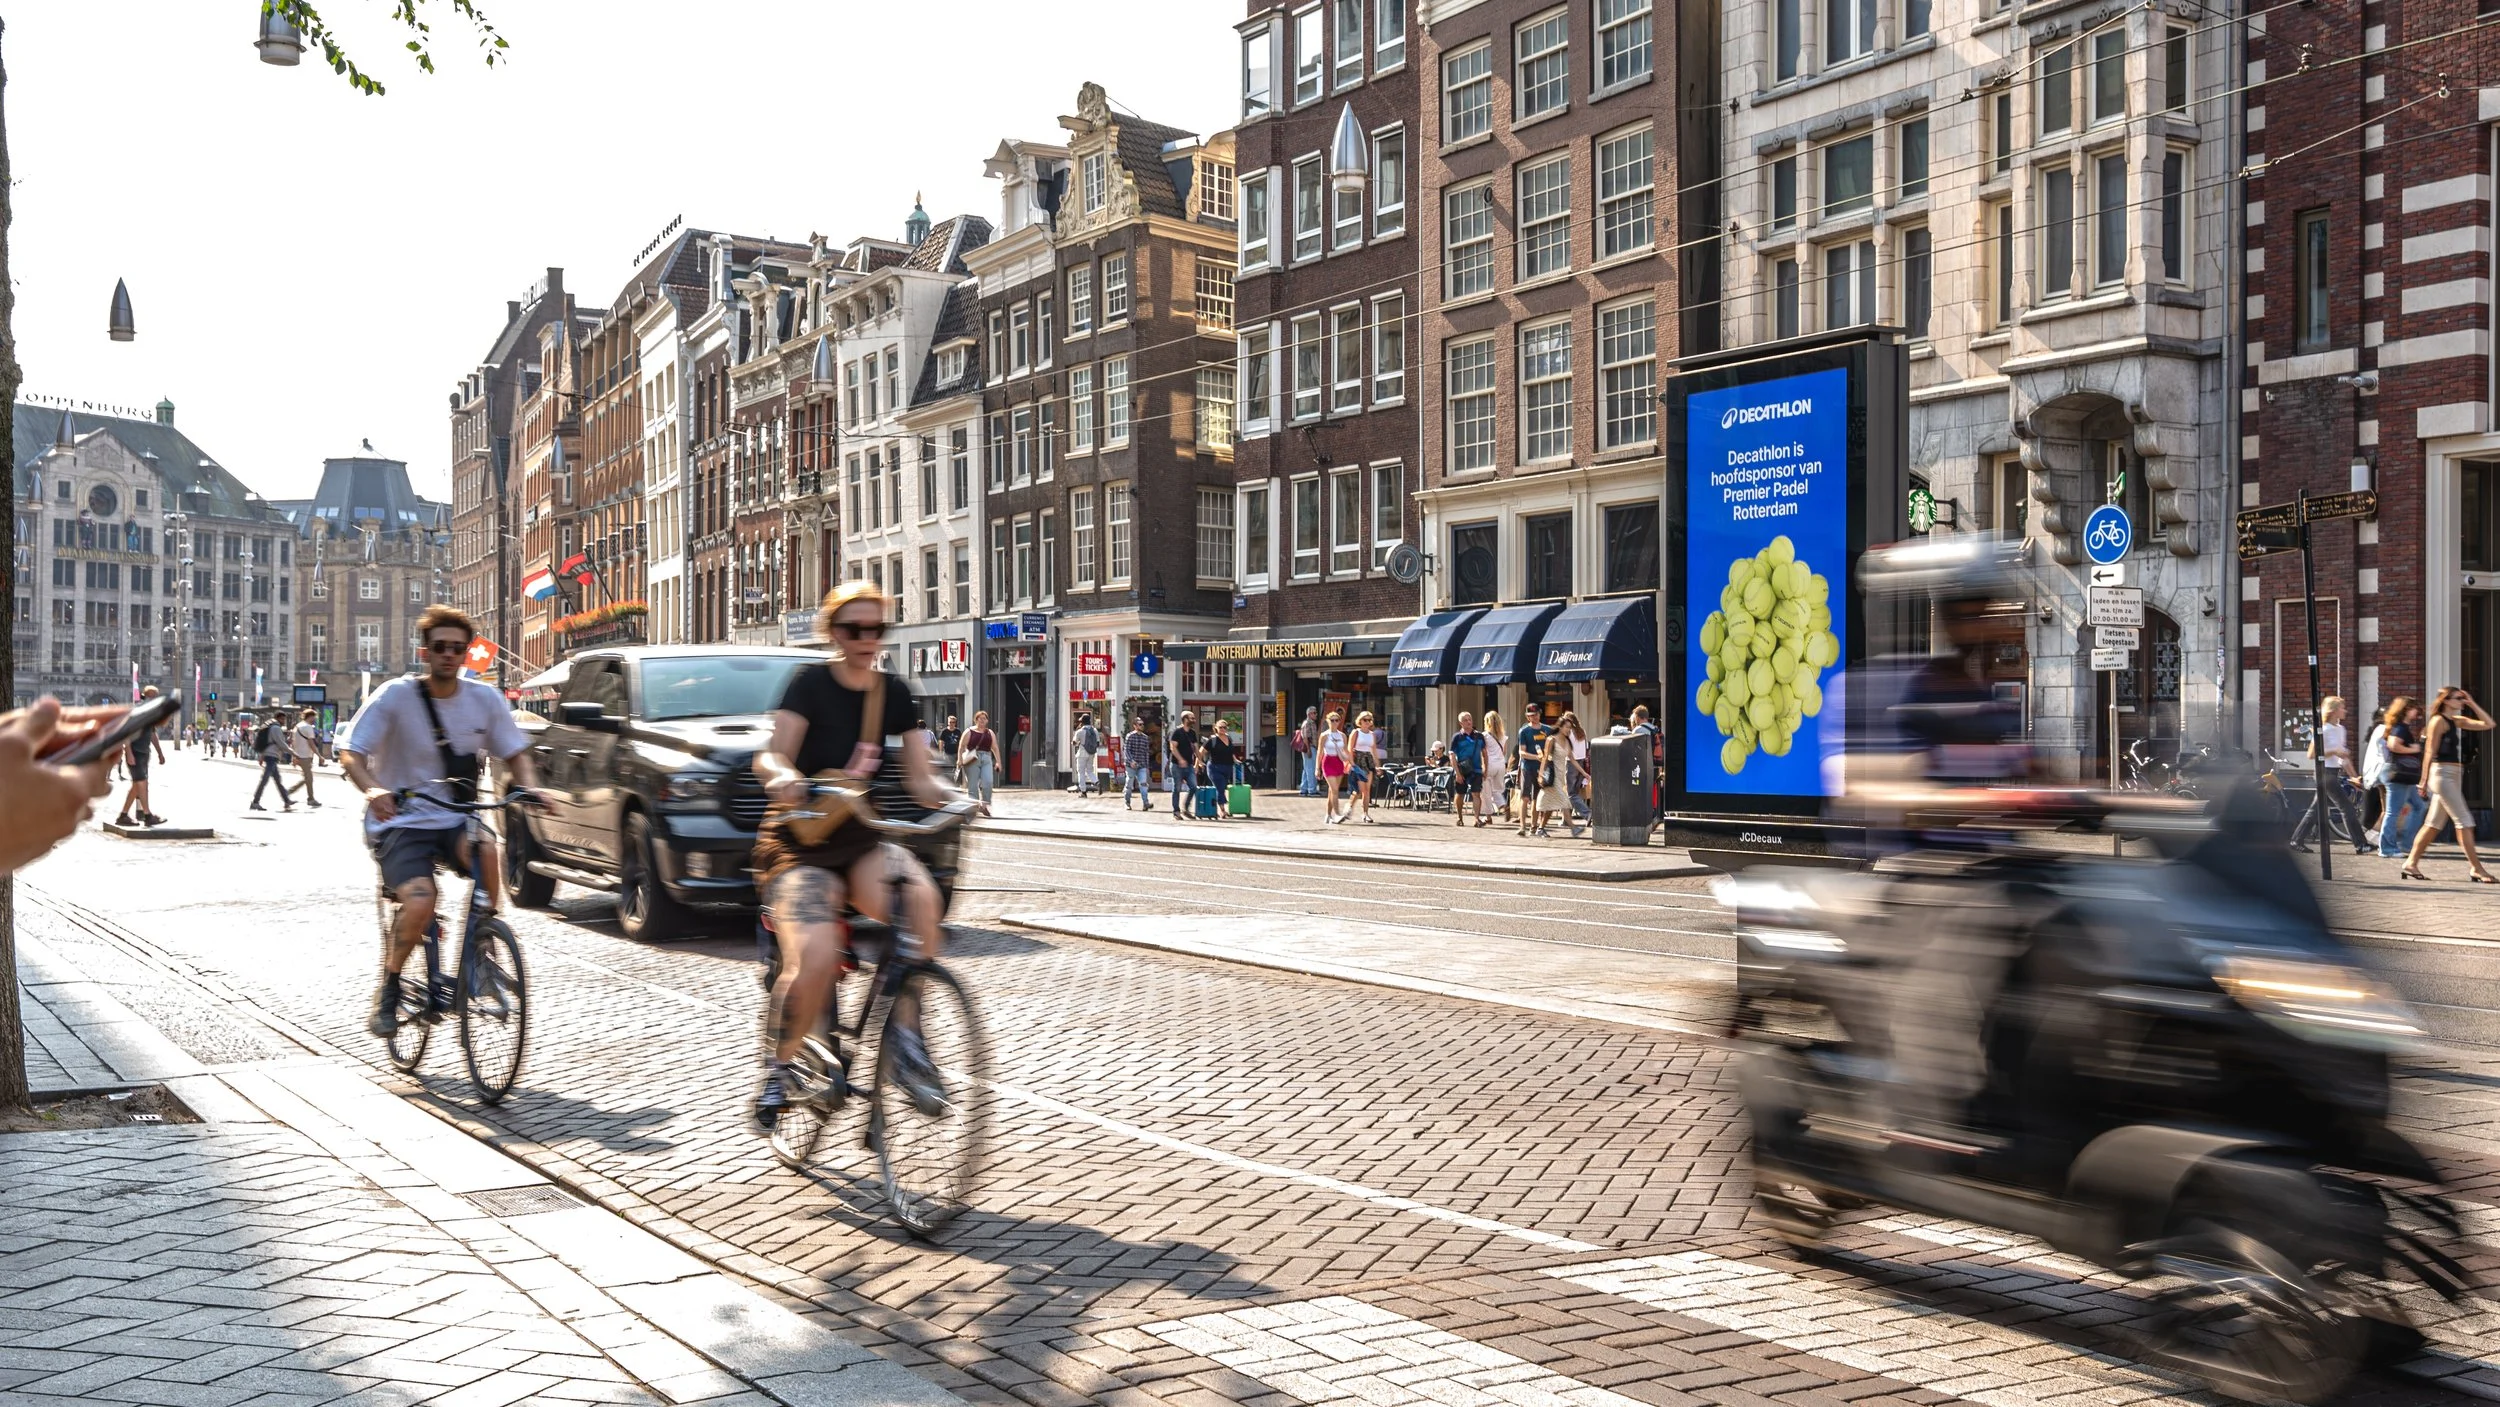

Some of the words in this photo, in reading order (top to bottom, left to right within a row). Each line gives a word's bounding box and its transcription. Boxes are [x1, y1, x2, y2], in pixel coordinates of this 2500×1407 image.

[16, 391, 153, 421] OPPENBURG
[1739, 398, 1812, 424] DECATHLON
[1728, 445, 1791, 466] Decathlon
[1793, 441, 1804, 457] is
[1711, 463, 1797, 486] hoofdsponsor
[1799, 460, 1822, 476] van
[1723, 484, 1771, 503] Premier
[1773, 478, 1809, 498] Padel
[1733, 501, 1798, 521] Rotterdam
[2102, 638, 2136, 647] toegestaan
[2105, 629, 2126, 637] fietsen
[2127, 630, 2133, 638] is
[1206, 645, 1260, 660] AMSTERDAM
[1262, 643, 1296, 658] CHEESE
[1298, 641, 1343, 657] COMPANY
[1085, 657, 1104, 665] TOURS
[1085, 664, 1108, 672] TICKETS
[1739, 832, 1783, 845] JCDecaux
